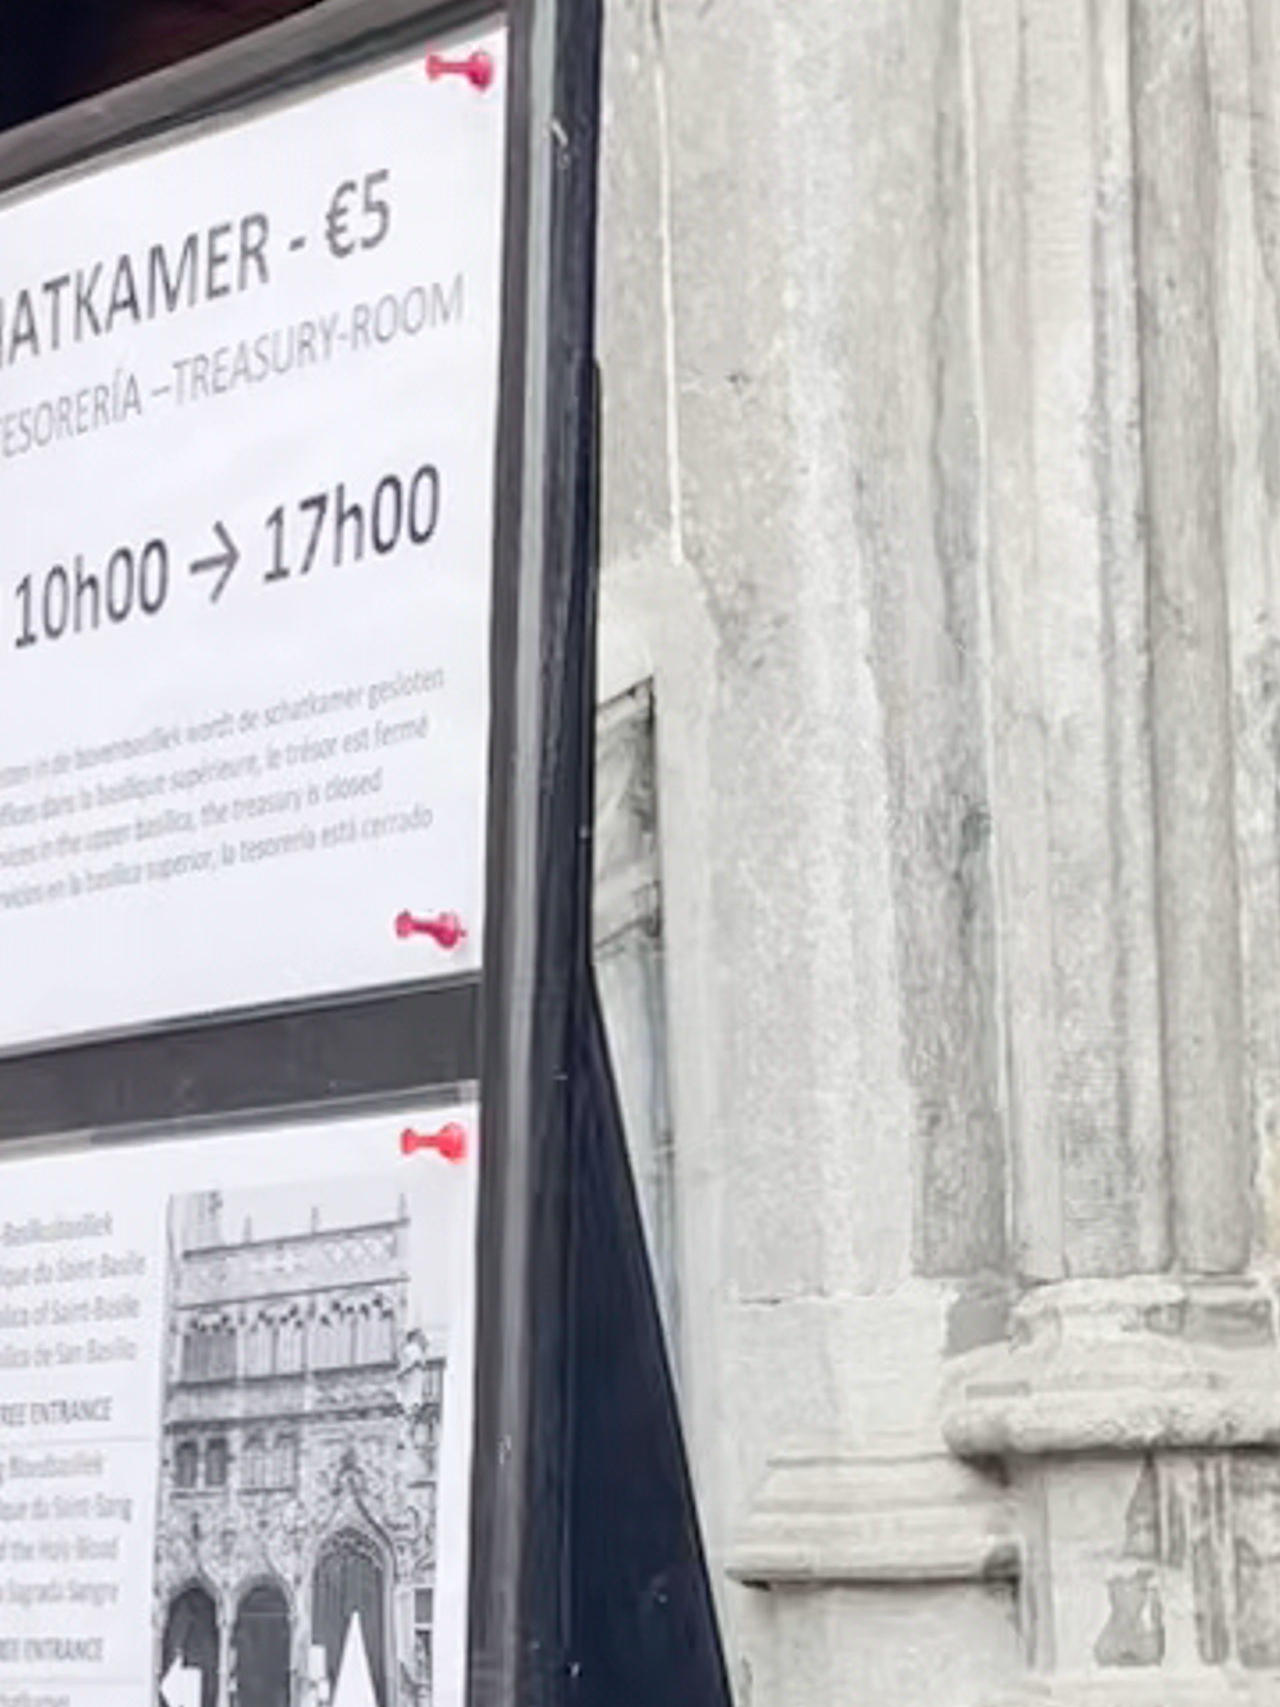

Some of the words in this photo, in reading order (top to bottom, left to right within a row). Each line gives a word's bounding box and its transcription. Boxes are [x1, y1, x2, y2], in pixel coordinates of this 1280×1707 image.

[324, 169, 389, 258] €5
[15, 539, 168, 647] 10h00
[265, 465, 439, 581] 17h00
[367, 668, 444, 710] gesloten
[341, 726, 369, 754] est
[373, 714, 429, 747] fermé
[199, 800, 228, 827] the
[231, 788, 303, 821] treasury
[324, 766, 383, 802] closed
[360, 802, 433, 839] cerrado
[29, 1396, 111, 1424] ENTRANCE
[23, 1637, 102, 1662] ENTRANCE
